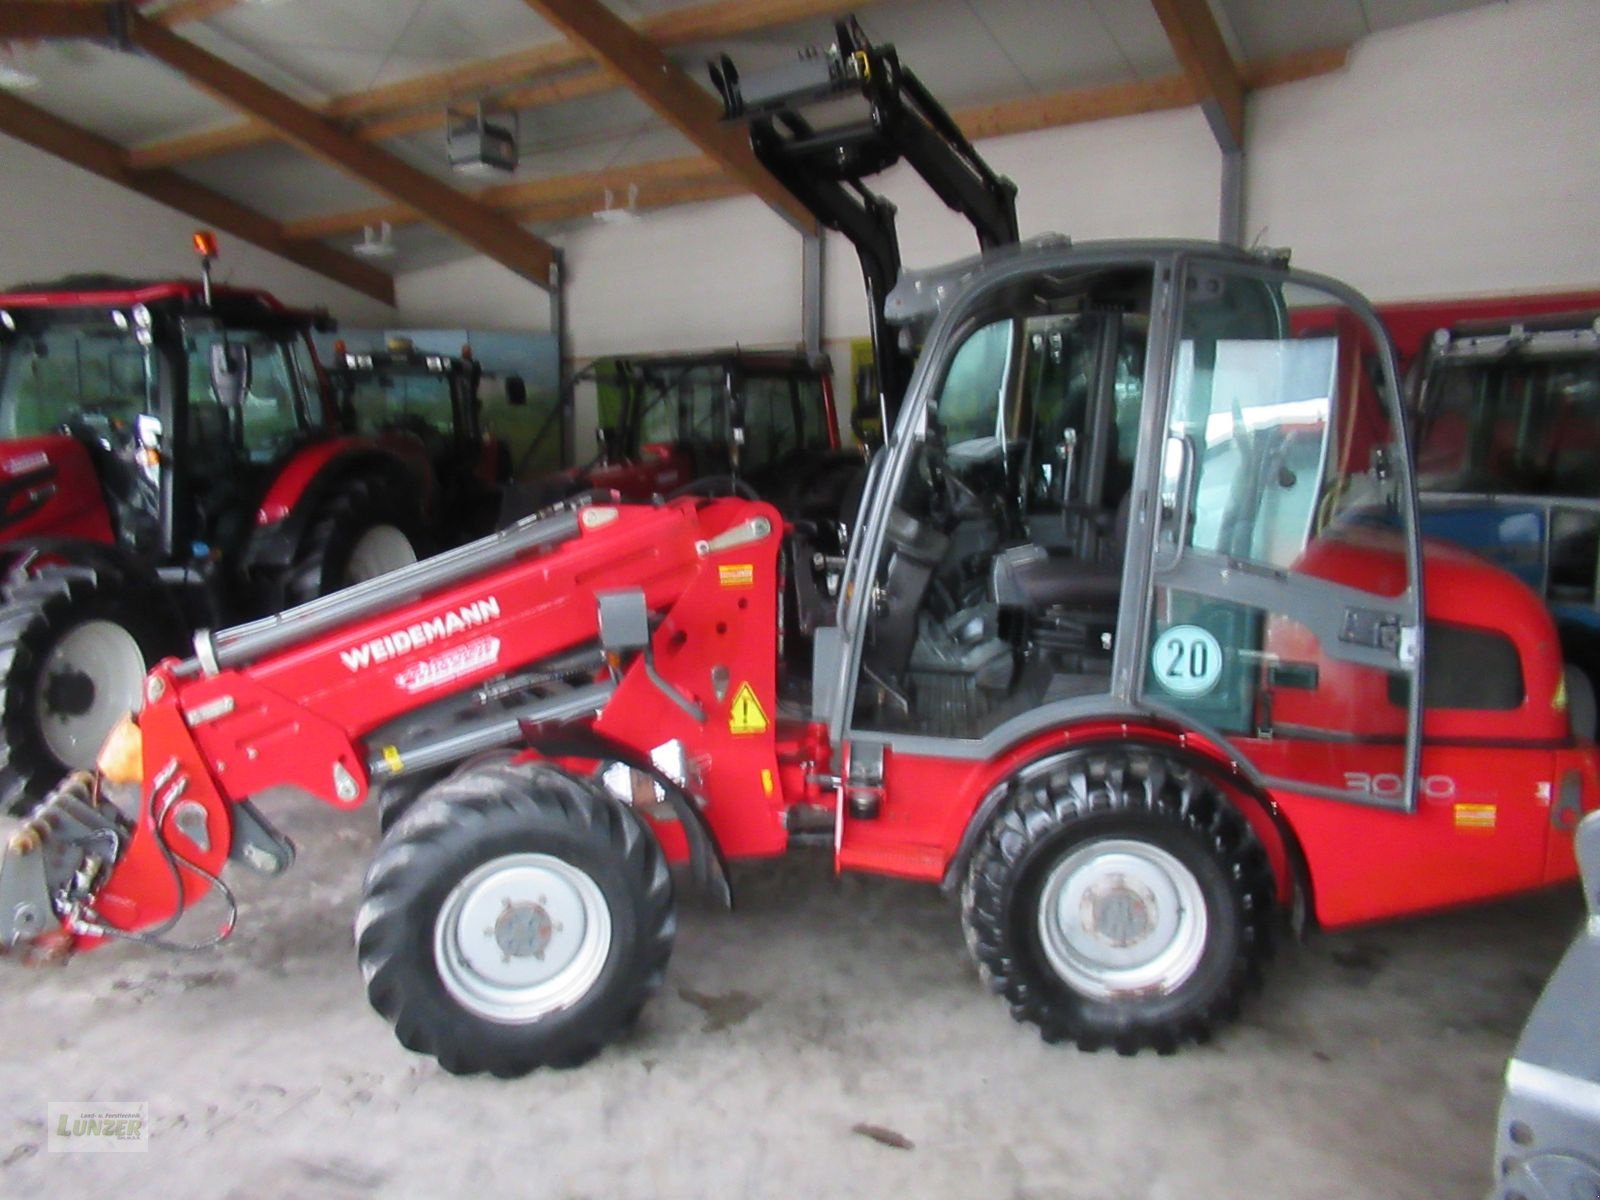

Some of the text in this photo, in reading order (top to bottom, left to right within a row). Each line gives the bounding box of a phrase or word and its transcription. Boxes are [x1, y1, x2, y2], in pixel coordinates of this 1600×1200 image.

[340, 596, 500, 672] WEIDEMANN
[1166, 638, 1208, 678] 20
[1343, 771, 1456, 798] 300
